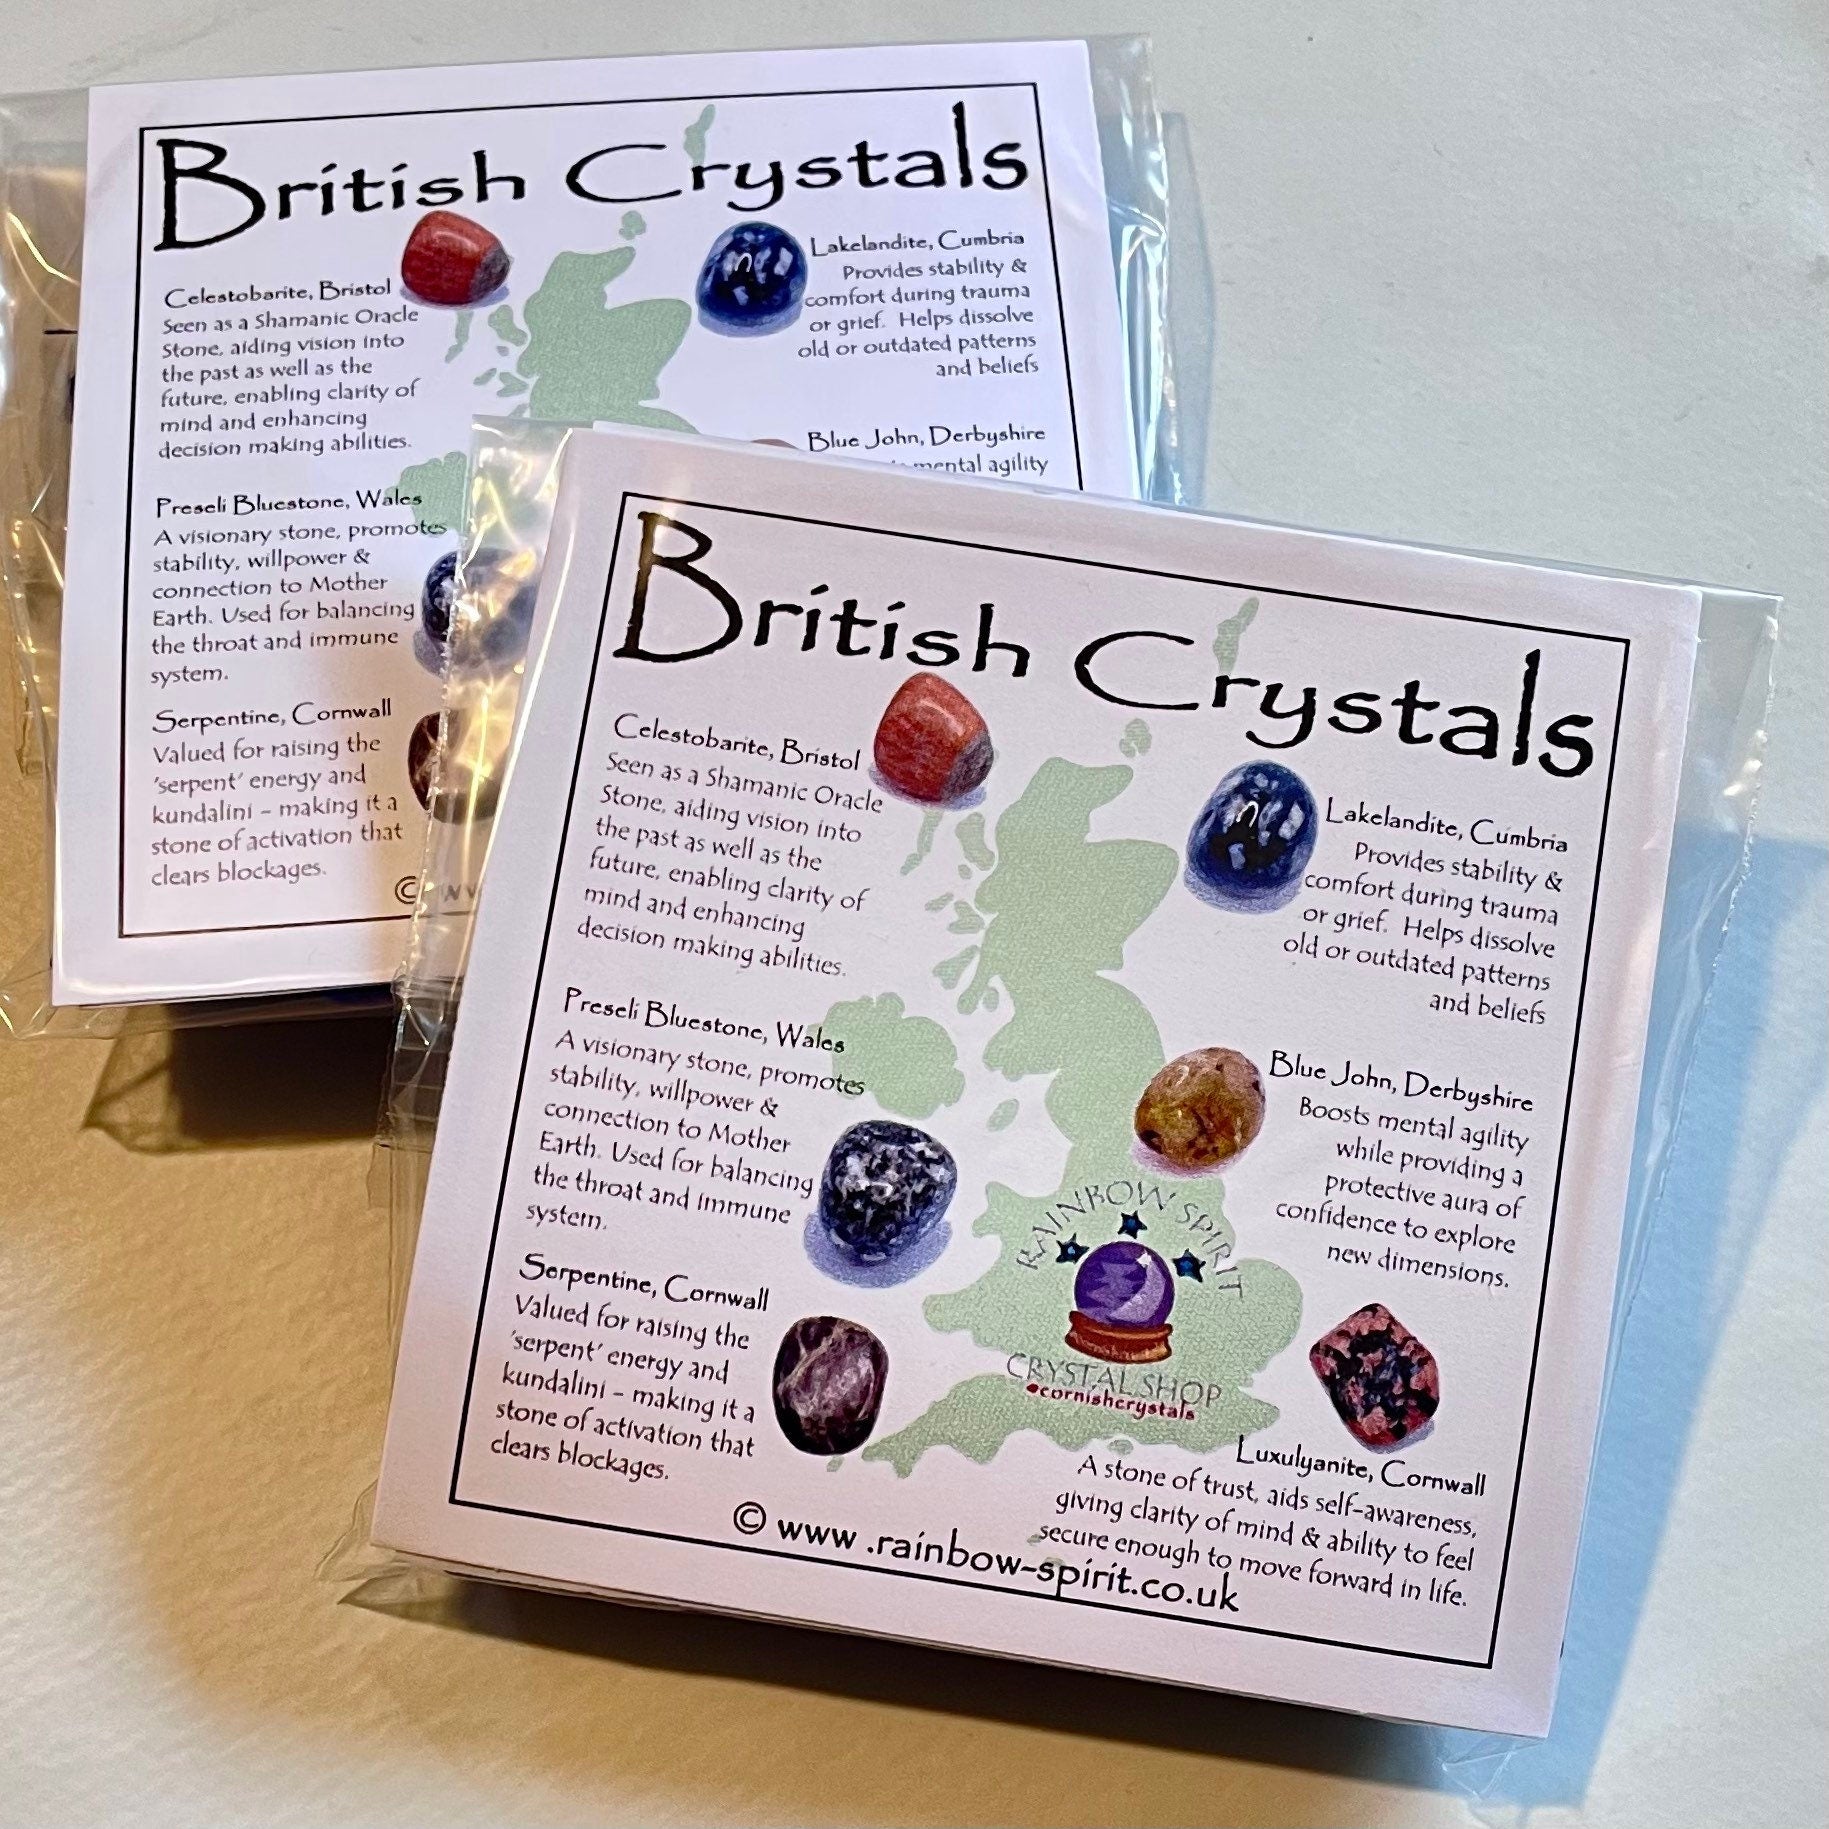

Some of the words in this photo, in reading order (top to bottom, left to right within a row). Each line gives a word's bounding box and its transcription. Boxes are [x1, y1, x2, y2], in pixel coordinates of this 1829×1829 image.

[153, 138, 526, 252] British
[565, 100, 1028, 213] Crystals
[810, 232, 935, 258] Lakelandite,
[936, 228, 1026, 252] Cumbria
[842, 261, 924, 281] Provides
[928, 256, 1006, 280] stability
[1010, 257, 1028, 275] &
[160, 318, 209, 336] Seen
[213, 319, 234, 333] as
[237, 317, 249, 332] a
[254, 310, 351, 331] Shamanic
[354, 304, 420, 326] Oracle
[164, 283, 315, 310] Celestobarite,
[318, 277, 392, 302] Bristol
[804, 285, 887, 309] comfort
[890, 286, 956, 307] during
[959, 284, 1031, 301] trauma
[809, 320, 833, 334] or
[836, 309, 887, 337] grief.
[899, 308, 955, 332] Helps
[958, 304, 1035, 327] dissolve
[160, 364, 195, 384] the
[199, 364, 241, 387] past
[244, 366, 265, 381] as
[269, 357, 309, 379] well
[314, 363, 335, 377] as
[339, 355, 374, 376] the
[161, 342, 225, 360] Stone,
[230, 336, 292, 358] aiding
[296, 336, 357, 352] vision
[363, 333, 406, 350] into
[797, 338, 831, 360] old
[835, 344, 859, 357] or
[862, 333, 953, 355] outdated
[958, 332, 1038, 356] patterns
[936, 358, 973, 378] and
[976, 352, 1040, 376] beliefs
[160, 387, 229, 409] future,
[234, 382, 322, 407] enabling
[326, 381, 390, 404] clarity
[394, 376, 423, 399] of
[158, 440, 242, 461] decision
[248, 435, 325, 458] making
[330, 431, 413, 453] abilities.
[160, 413, 213, 434] mind
[218, 411, 257, 432] and
[262, 408, 368, 431] enhancing
[807, 429, 861, 454] Blue
[864, 427, 926, 451] John,
[928, 422, 1046, 449] Derbyshire
[987, 451, 1050, 479] agility
[156, 494, 227, 520] Preseli
[232, 492, 351, 517] Bluestone,
[355, 485, 424, 510] Wales
[612, 510, 1031, 678] British
[1074, 630, 1594, 779] Crystals
[613, 712, 775, 762] Celestobarite,
[778, 737, 862, 772] Bristol
[1325, 796, 1464, 842] Lakelandite,
[1469, 818, 1569, 854] Cumbria
[562, 986, 641, 1022] Preseli
[644, 1000, 769, 1046] Bluestone,
[776, 1020, 846, 1060] Wales
[549, 1063, 641, 1102] stability,
[650, 1077, 755, 1113] willpower
[759, 1096, 780, 1119] &
[554, 1028, 576, 1051] A
[582, 1036, 683, 1075] visionary
[685, 1050, 753, 1081] stone,
[758, 1065, 866, 1098] promotes
[1268, 1049, 1328, 1081] Blue
[1329, 1060, 1398, 1096] John,
[1402, 1070, 1535, 1113] Derbyshire
[544, 1102, 671, 1137] connection
[675, 1117, 703, 1141] to
[706, 1121, 792, 1154] Mother
[1299, 1095, 1371, 1127] Boosts
[1378, 1114, 1456, 1142] mental
[1459, 1122, 1531, 1159] agility
[538, 1129, 602, 1160] Earth.
[612, 1141, 665, 1172] Used
[671, 1144, 705, 1175] for
[710, 1153, 815, 1201] balancing
[1336, 1135, 1395, 1166] while
[1399, 1151, 1506, 1191] providing
[1511, 1169, 1524, 1189] a
[525, 1204, 608, 1232] system.
[534, 1160, 570, 1191] the
[574, 1167, 645, 1203] throat
[648, 1184, 691, 1212] and
[696, 1192, 792, 1225] immune
[1324, 1174, 1437, 1208] protective
[1440, 1192, 1489, 1218] aura
[1495, 1194, 1528, 1220] of
[1016, 1180, 1177, 1271] RAINBOW
[1174, 1202, 1244, 1299] SPIRIT
[1275, 1198, 1398, 1237] confidence
[1403, 1216, 1429, 1240] to
[1433, 1223, 1517, 1255] explore
[518, 1252, 658, 1301] Serpentine,
[664, 1273, 771, 1313] Cornwall
[1326, 1245, 1373, 1266] new
[1376, 1246, 1510, 1291] dimensions.
[515, 1292, 590, 1329] Valued
[596, 1301, 631, 1331] for
[635, 1316, 708, 1351] raising
[712, 1320, 751, 1351] the
[502, 1360, 607, 1401] kundalini
[632, 1380, 716, 1425] making
[718, 1398, 740, 1421] it
[743, 1405, 756, 1425] a
[606, 1350, 685, 1383] energy
[687, 1358, 730, 1386] and
[1006, 1352, 1133, 1397] CRYSTAL
[1138, 1372, 1222, 1408] SHOP
[490, 1428, 552, 1462] clears
[557, 1437, 670, 1484] blockages.
[495, 1398, 558, 1429] stone
[563, 1406, 595, 1433] of
[592, 1406, 707, 1451] activation
[706, 1423, 756, 1459] that
[1234, 1434, 1376, 1486] Luxulyanite,
[1380, 1458, 1488, 1498] Cornwall
[1076, 1454, 1099, 1478] A
[1103, 1459, 1168, 1488] stone
[1171, 1466, 1204, 1493] of
[1200, 1468, 1260, 1505] trust,
[1266, 1485, 1312, 1513] aids
[1315, 1488, 1478, 1540] self-awareness,
[776, 1518, 858, 1551] www
[1055, 1489, 1124, 1525] giving
[1125, 1495, 1203, 1536] clarity
[1200, 1507, 1237, 1535] of
[1236, 1519, 1296, 1547] mind
[1300, 1526, 1324, 1550] &
[1326, 1527, 1399, 1568] ability
[1397, 1542, 1430, 1566] to
[1435, 1541, 1476, 1573] feel
[1039, 1524, 1114, 1552] secure
[1112, 1536, 1201, 1570] enough
[1207, 1546, 1237, 1572] to
[1238, 1556, 1307, 1583] move
[1308, 1561, 1394, 1600] forward
[1400, 1578, 1427, 1602] in
[1424, 1575, 1468, 1608] life.
